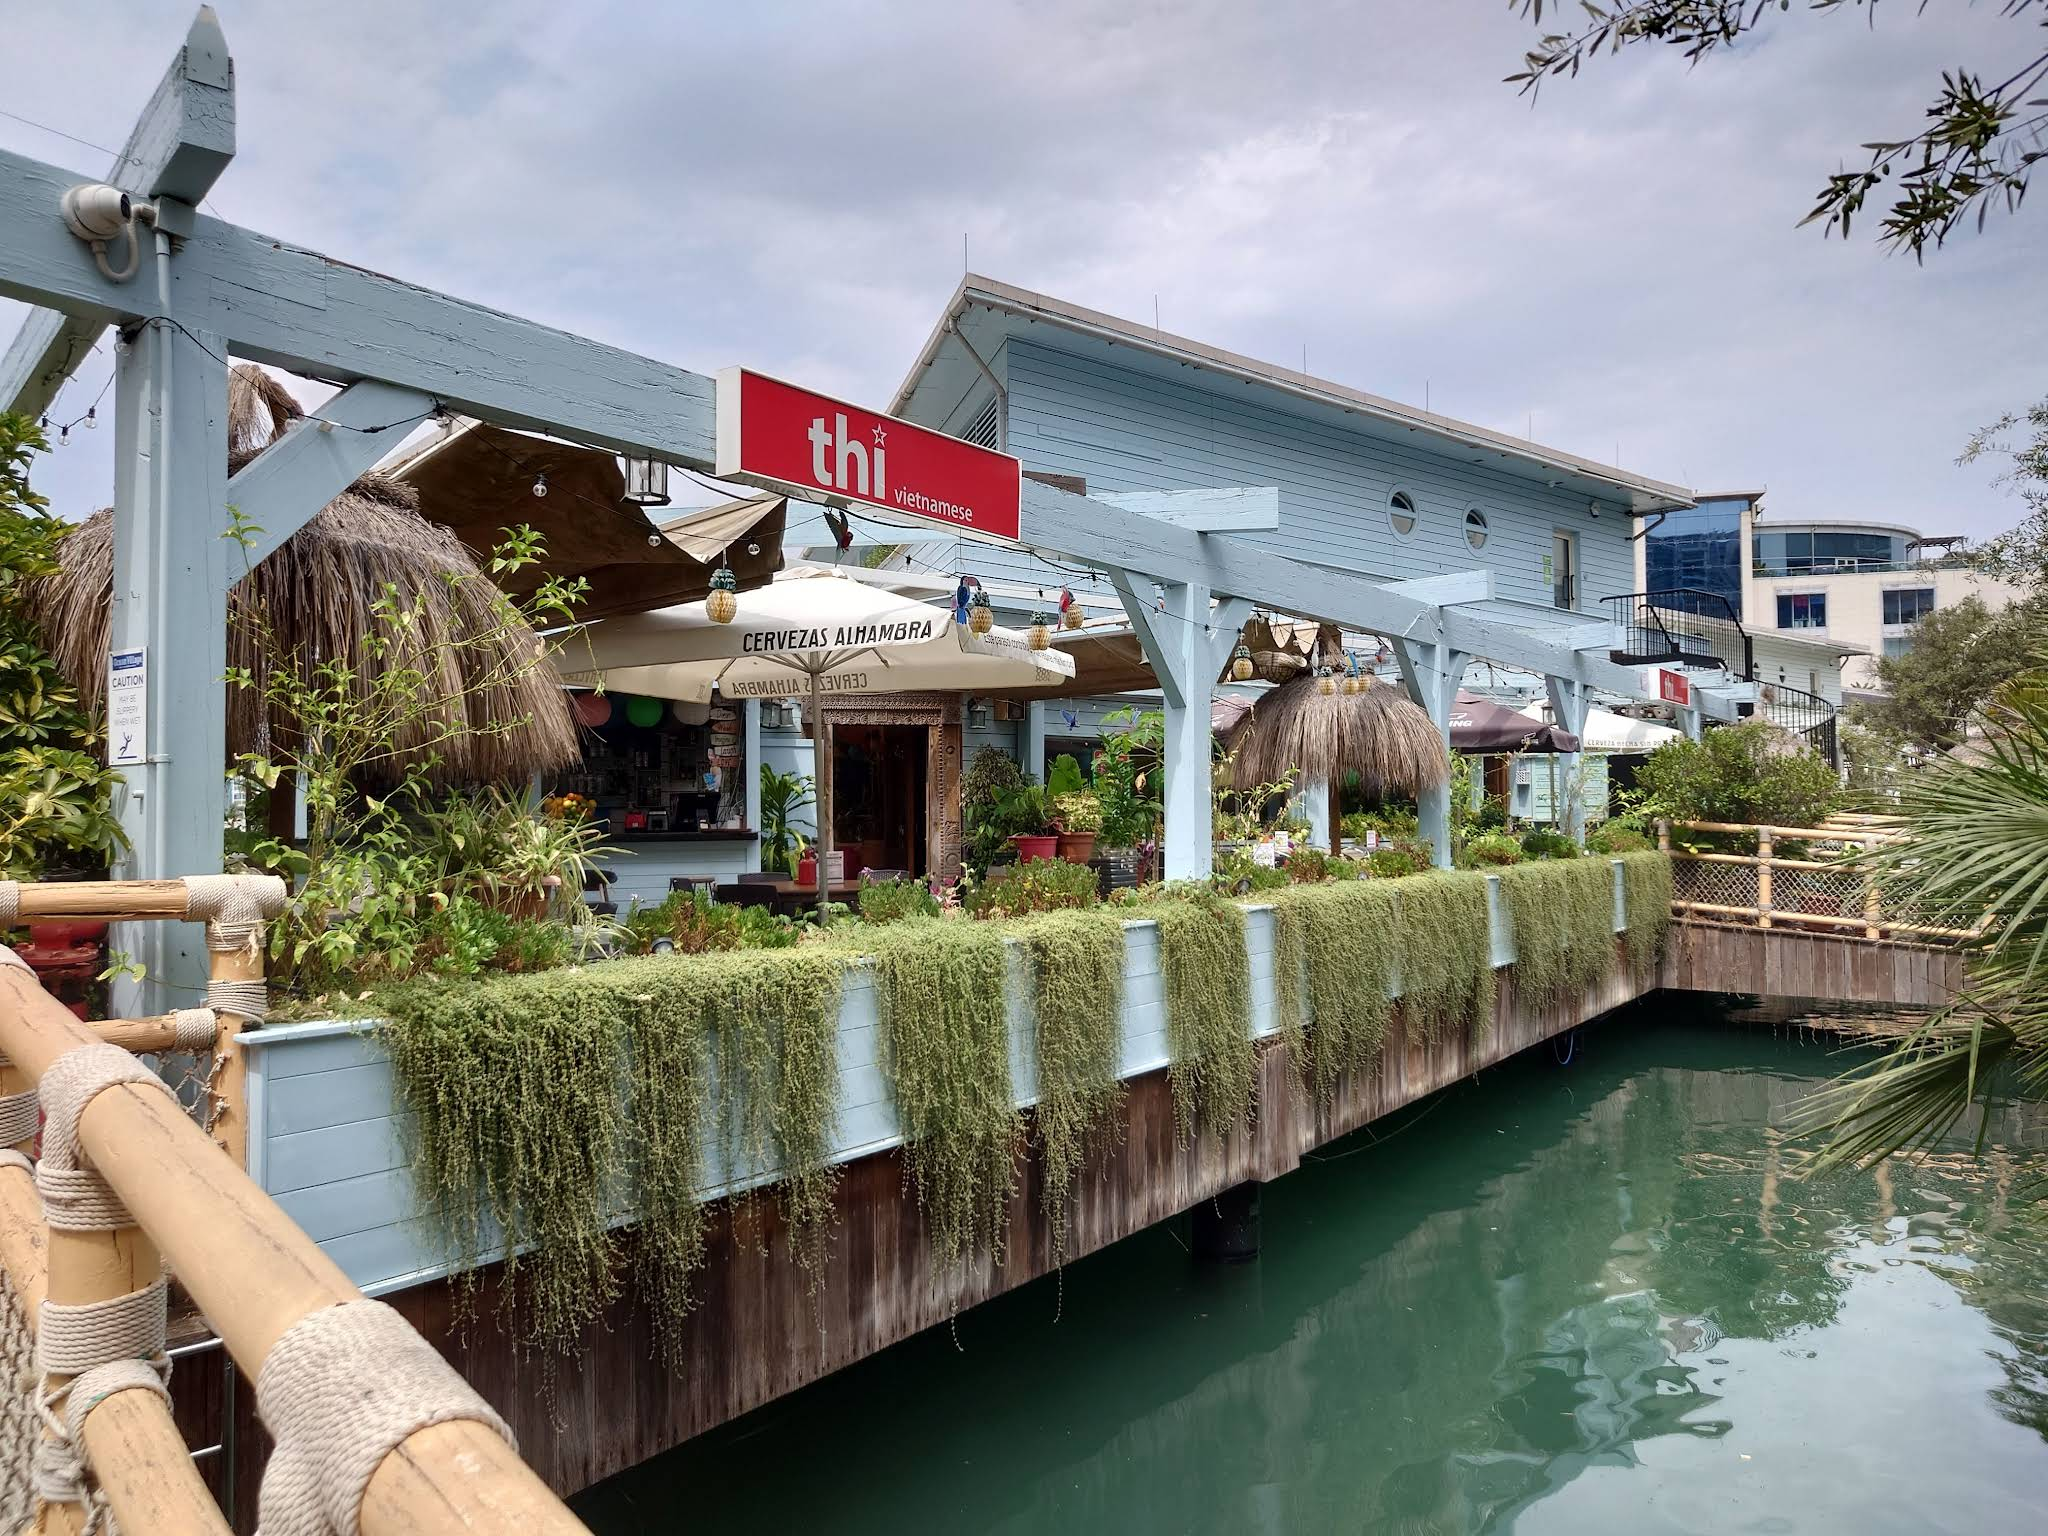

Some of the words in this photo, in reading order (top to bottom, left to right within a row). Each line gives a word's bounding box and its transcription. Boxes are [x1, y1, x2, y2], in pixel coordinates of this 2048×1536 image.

[808, 413, 887, 500] thi
[894, 486, 973, 523] vietnamese
[743, 627, 830, 653] CERVEZAS
[834, 619, 933, 646] ALHAMBRA
[112, 674, 144, 688] CAUTION
[1587, 739, 1615, 747] CERVEZA
